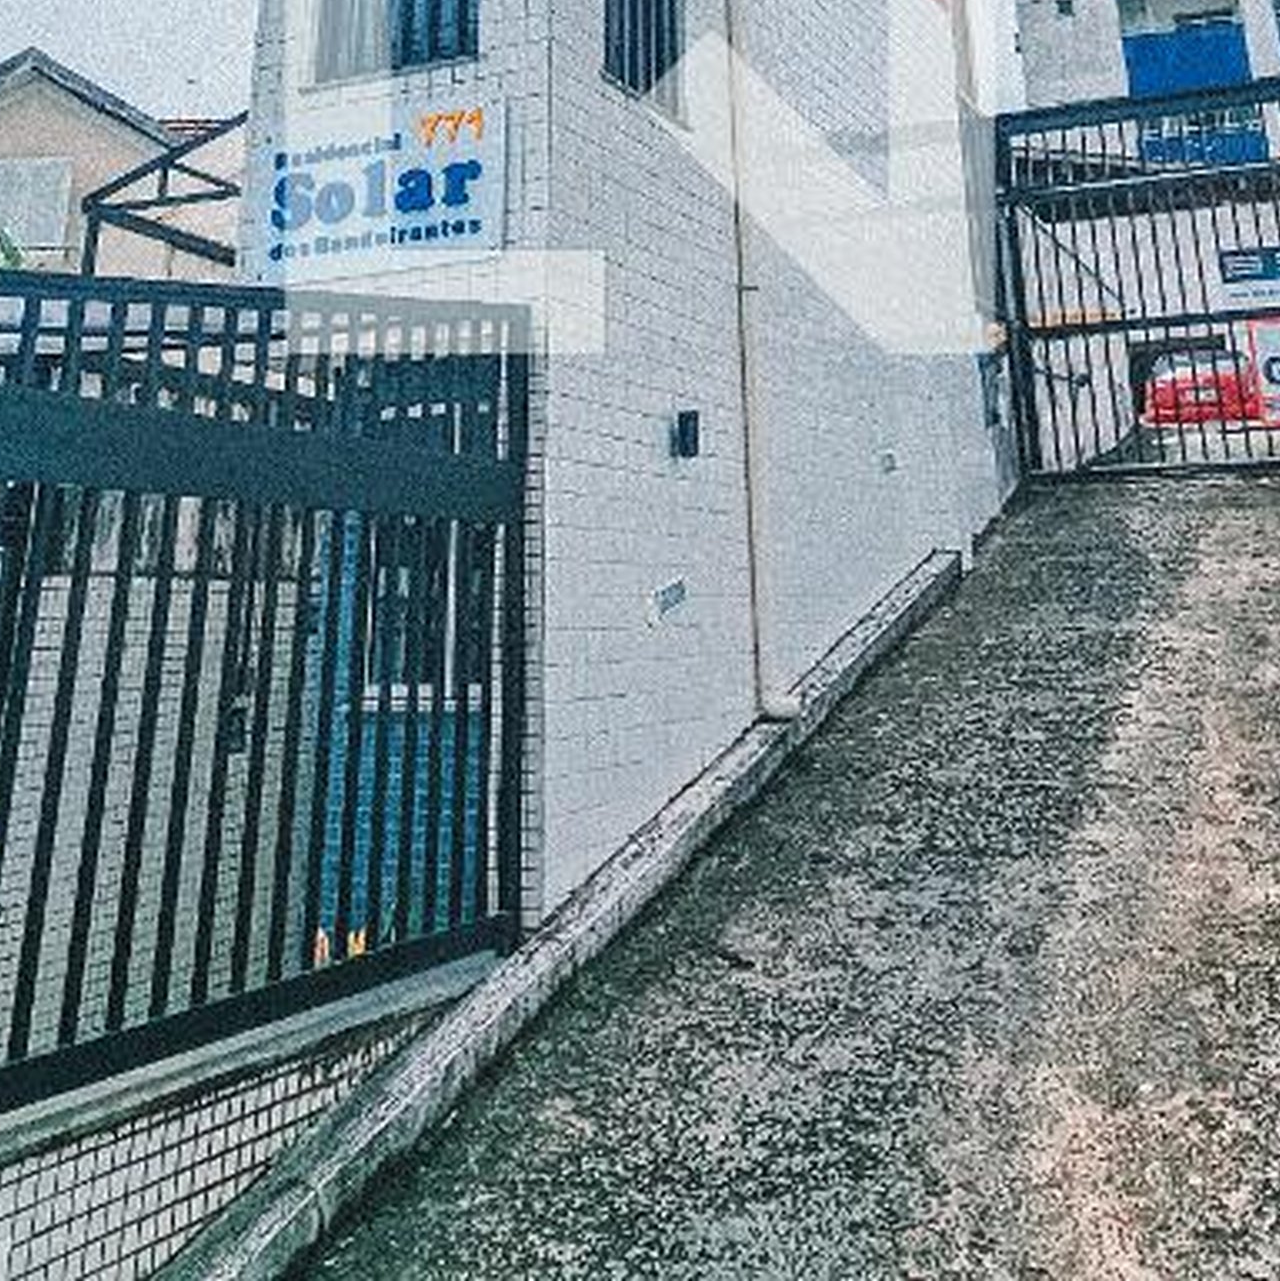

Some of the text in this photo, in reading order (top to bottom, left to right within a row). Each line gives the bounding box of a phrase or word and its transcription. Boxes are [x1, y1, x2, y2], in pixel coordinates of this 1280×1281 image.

[274, 132, 402, 170] Residencial
[271, 159, 483, 232] Solar
[269, 218, 483, 262] dos Bandeirantes
